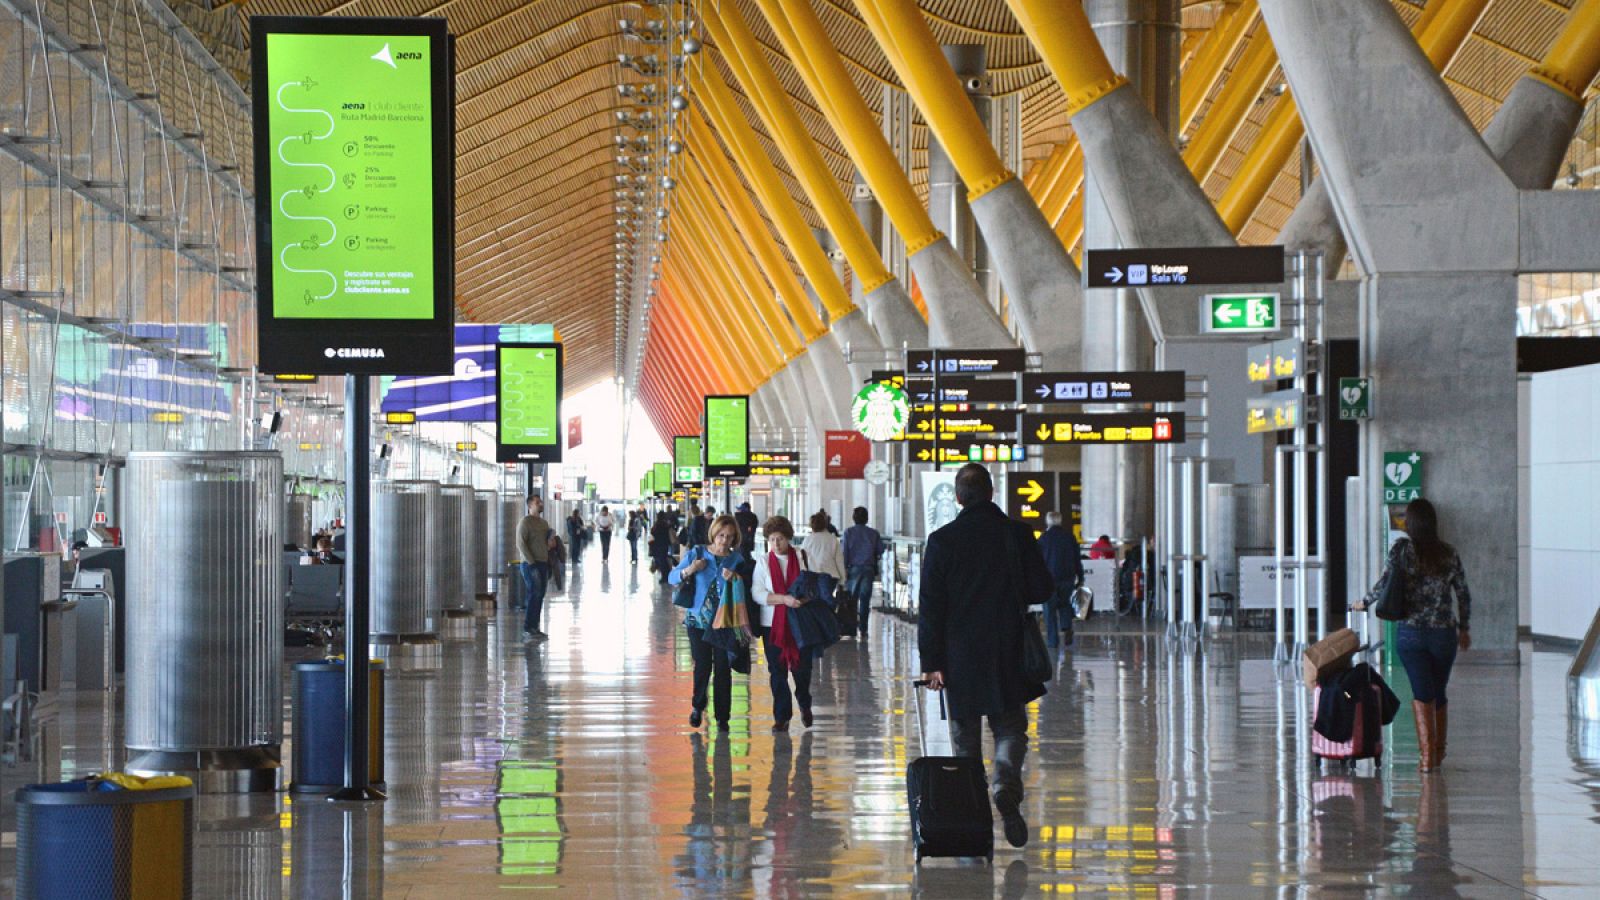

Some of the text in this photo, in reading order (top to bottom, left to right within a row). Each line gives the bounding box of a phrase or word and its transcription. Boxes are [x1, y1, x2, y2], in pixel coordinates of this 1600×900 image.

[395, 51, 422, 60] aena
[341, 102, 366, 110] aena
[360, 112, 386, 121] Madrid
[387, 112, 424, 121] Barcelona
[1151, 274, 1171, 283] Sala
[337, 348, 385, 358] CEMUSA
[1341, 409, 1368, 418] DEA
[1073, 431, 1102, 441] Puertas
[1157, 425, 1169, 438] H
[1385, 489, 1420, 501] DEA
